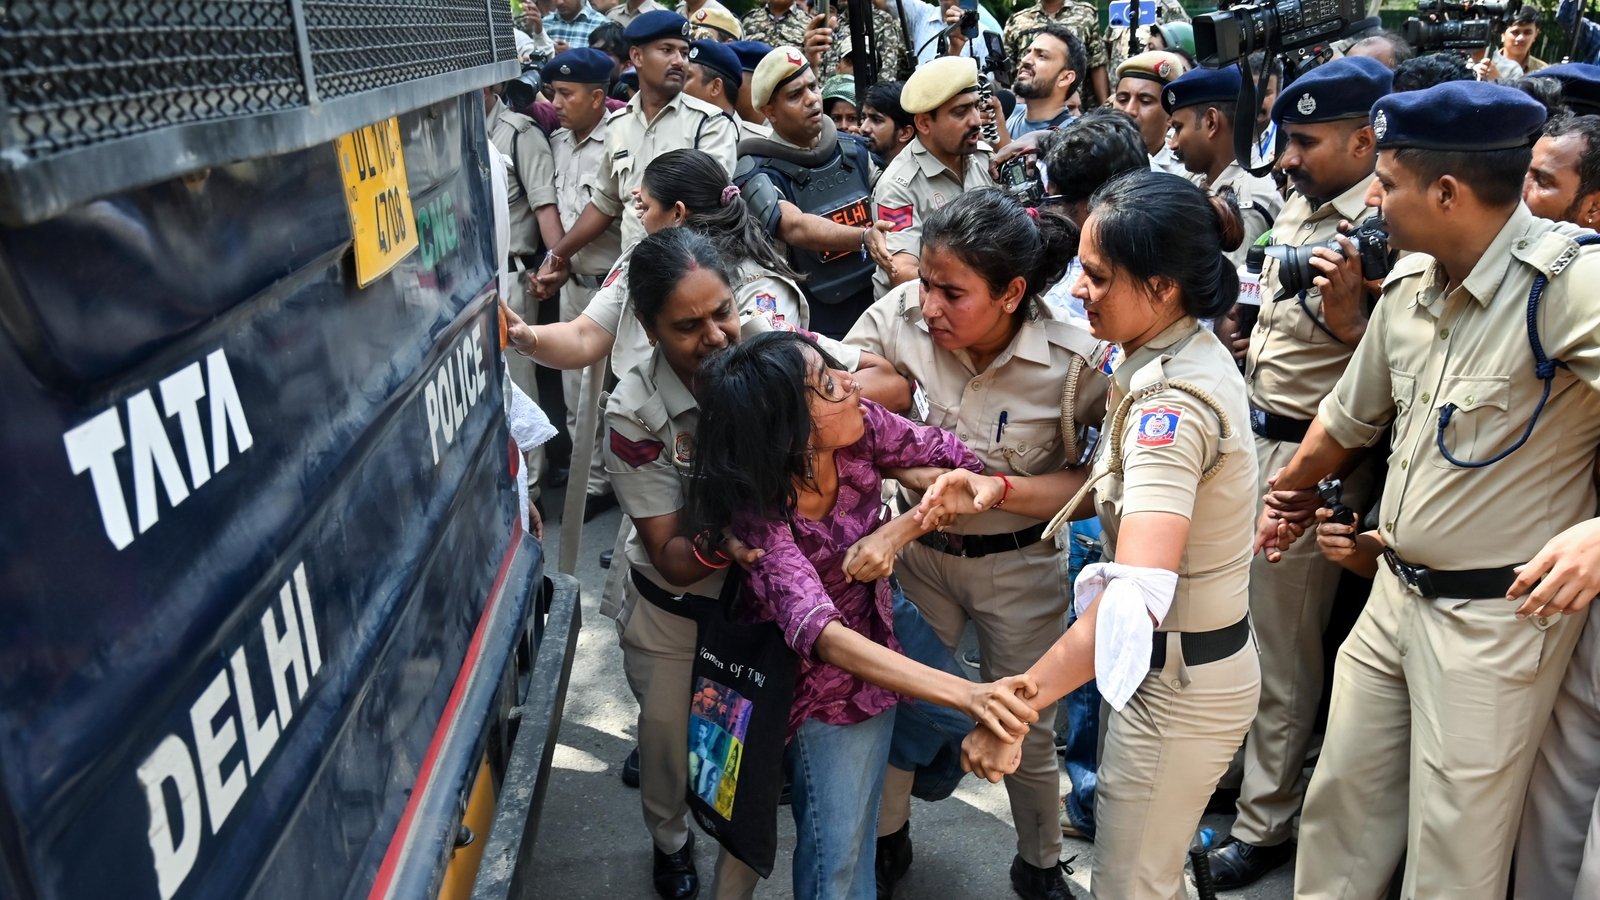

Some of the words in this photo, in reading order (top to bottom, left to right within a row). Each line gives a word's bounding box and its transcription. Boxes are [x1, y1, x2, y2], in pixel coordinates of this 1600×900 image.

[374, 185, 406, 256] 4708
[417, 191, 459, 271] CNG
[832, 203, 867, 226] ELHI
[425, 322, 486, 465] POLICE
[62, 347, 254, 551] TATA
[729, 662, 744, 679] Of
[136, 561, 322, 900] DELHI
